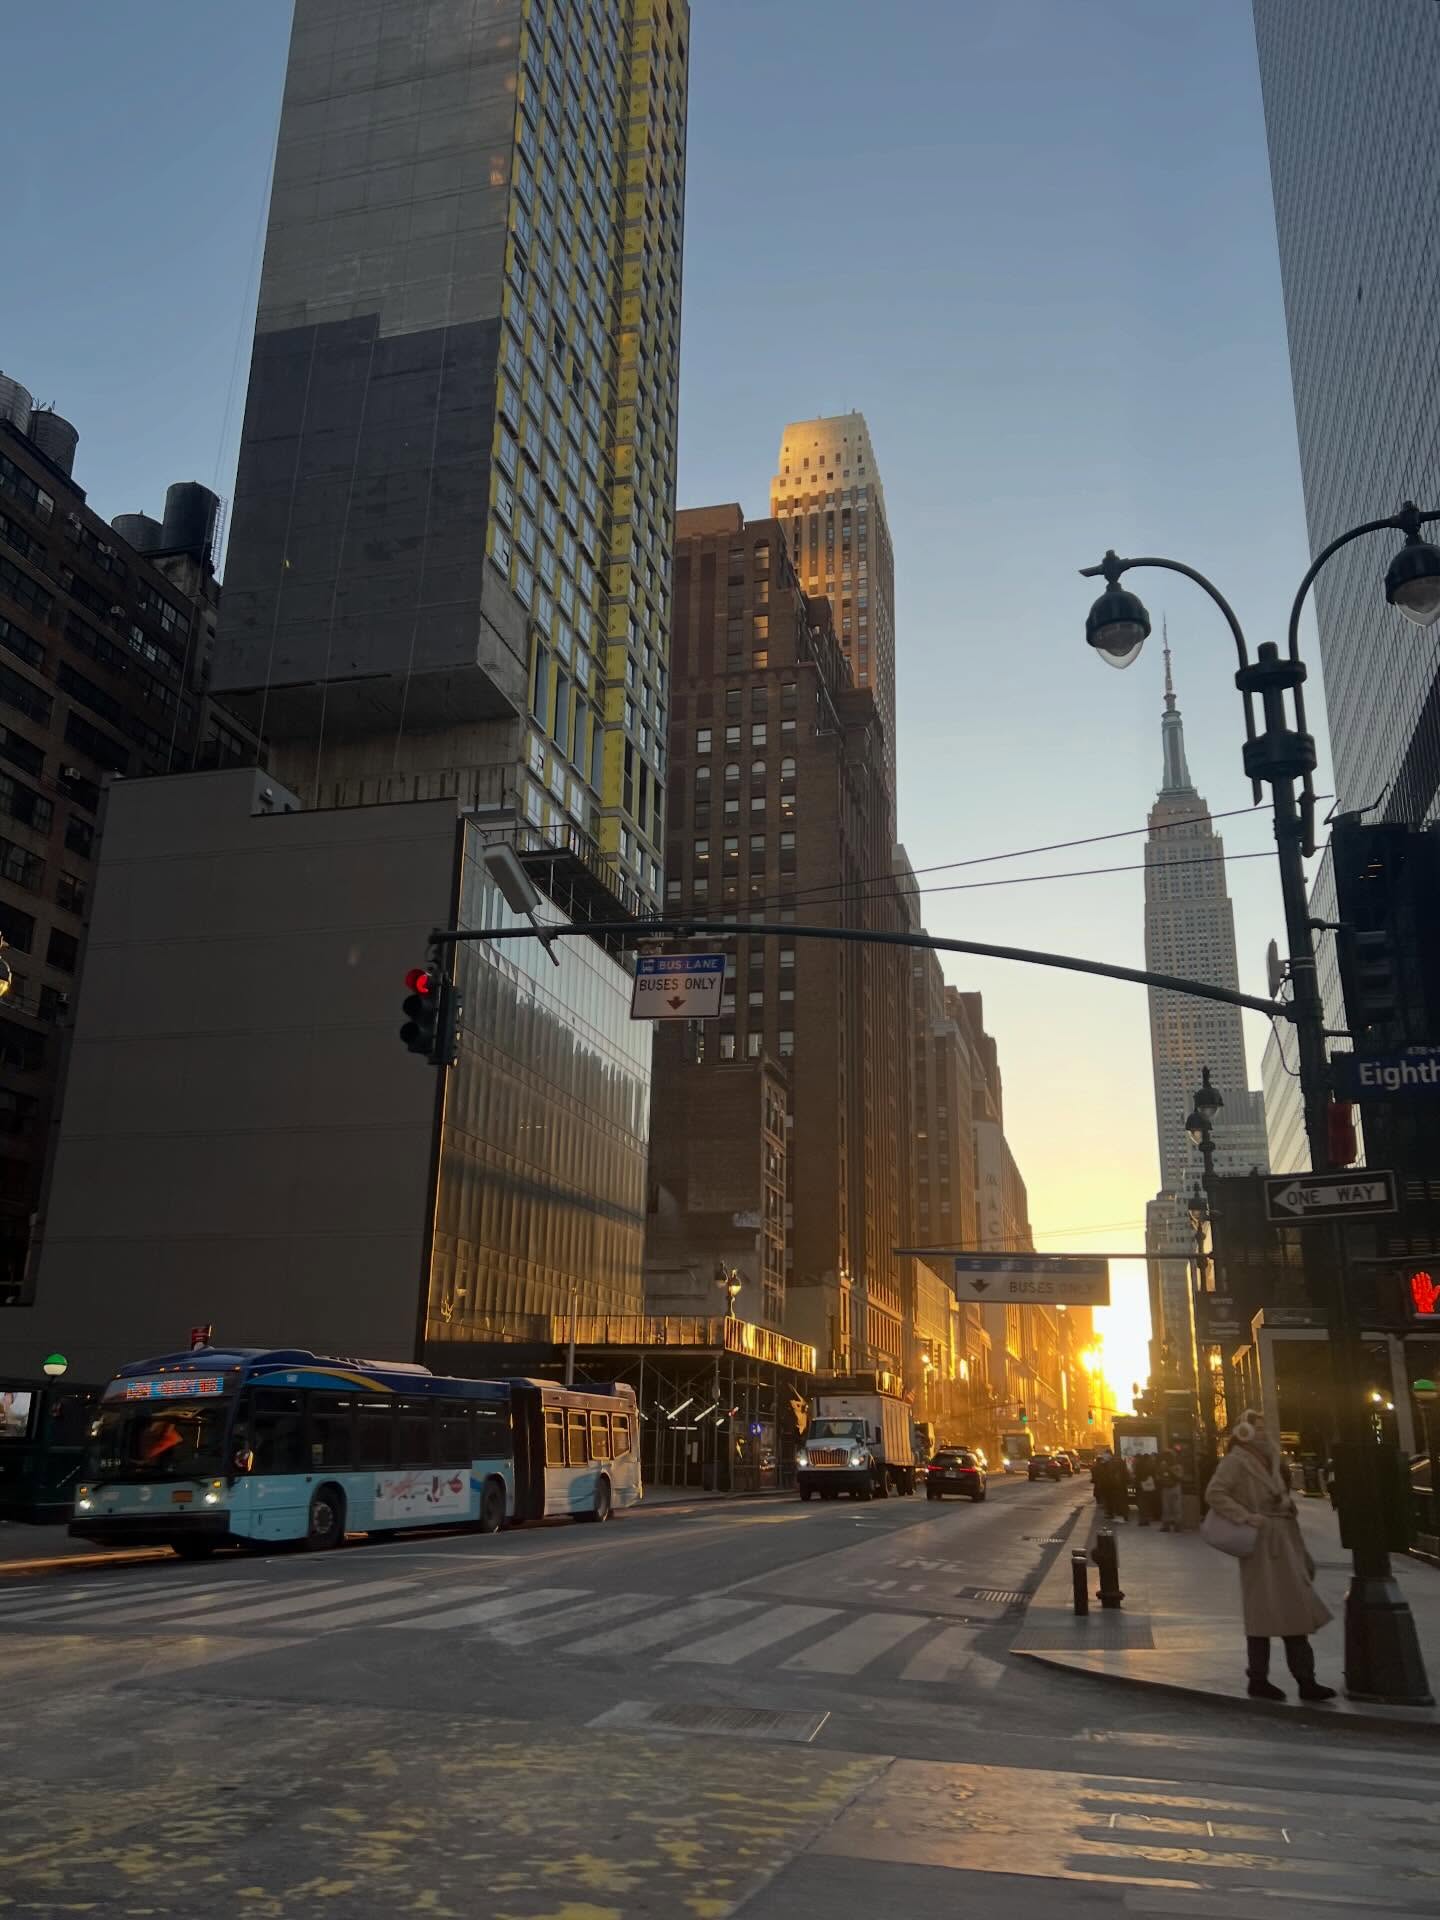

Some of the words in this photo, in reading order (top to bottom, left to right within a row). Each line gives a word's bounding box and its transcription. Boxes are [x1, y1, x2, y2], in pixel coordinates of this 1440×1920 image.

[659, 960, 682, 969] BUS
[687, 959, 718, 968] LANE
[640, 978, 679, 991] BUSES
[685, 978, 716, 990] ONLY
[1360, 1059, 1440, 1090] Eighth
[1287, 1190, 1320, 1207] ONE
[1337, 1186, 1375, 1203] WAY
[1009, 1281, 1054, 1294] BUSES
